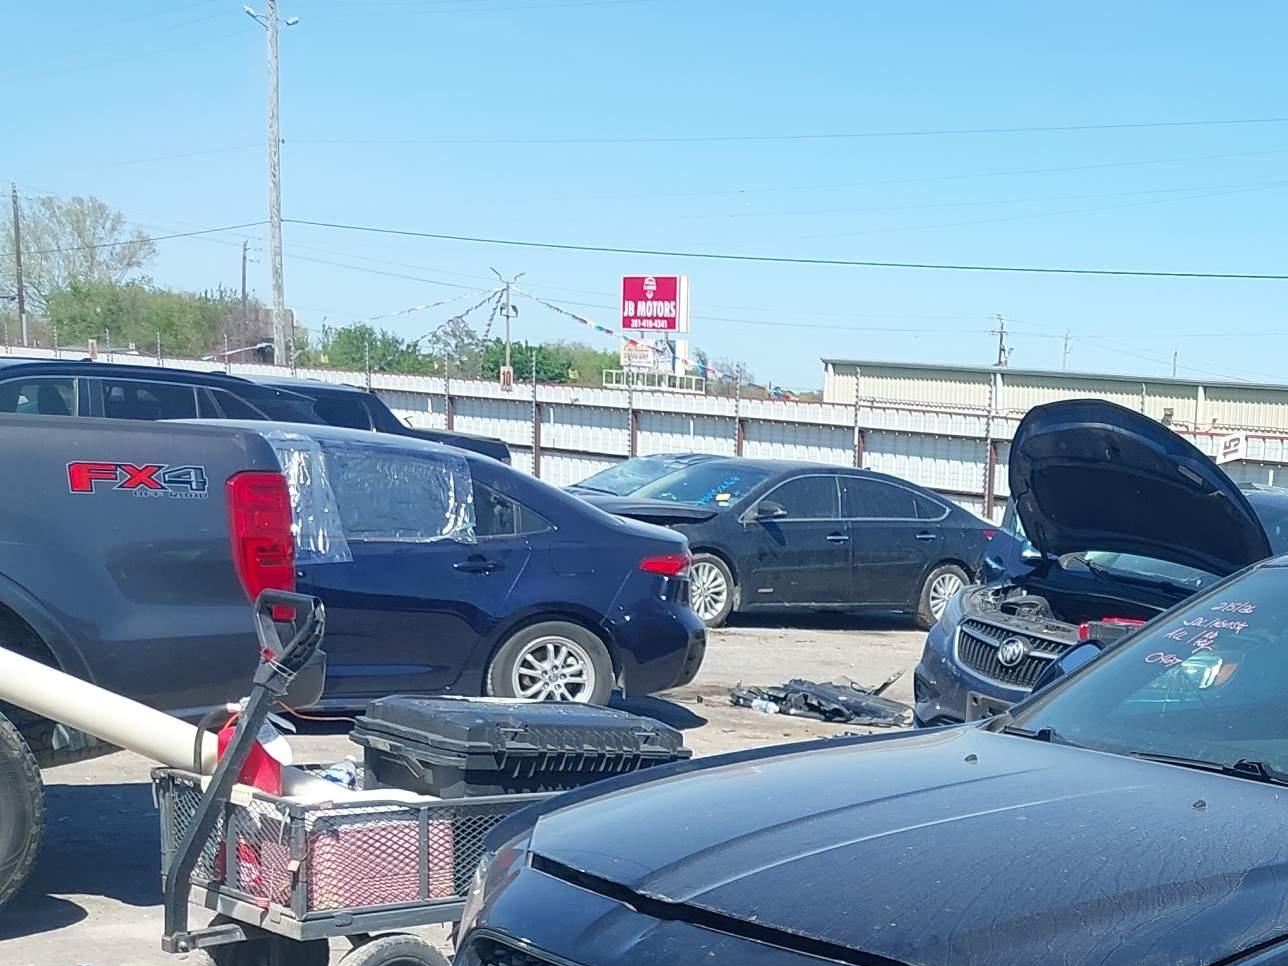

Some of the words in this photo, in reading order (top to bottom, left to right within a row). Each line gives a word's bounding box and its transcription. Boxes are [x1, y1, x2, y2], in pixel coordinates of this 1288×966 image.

[623, 300, 635, 317] JB
[636, 300, 676, 318] MOTORS
[502, 370, 512, 386] 10
[1223, 437, 1241, 458] 15
[66, 461, 208, 494] FX4
